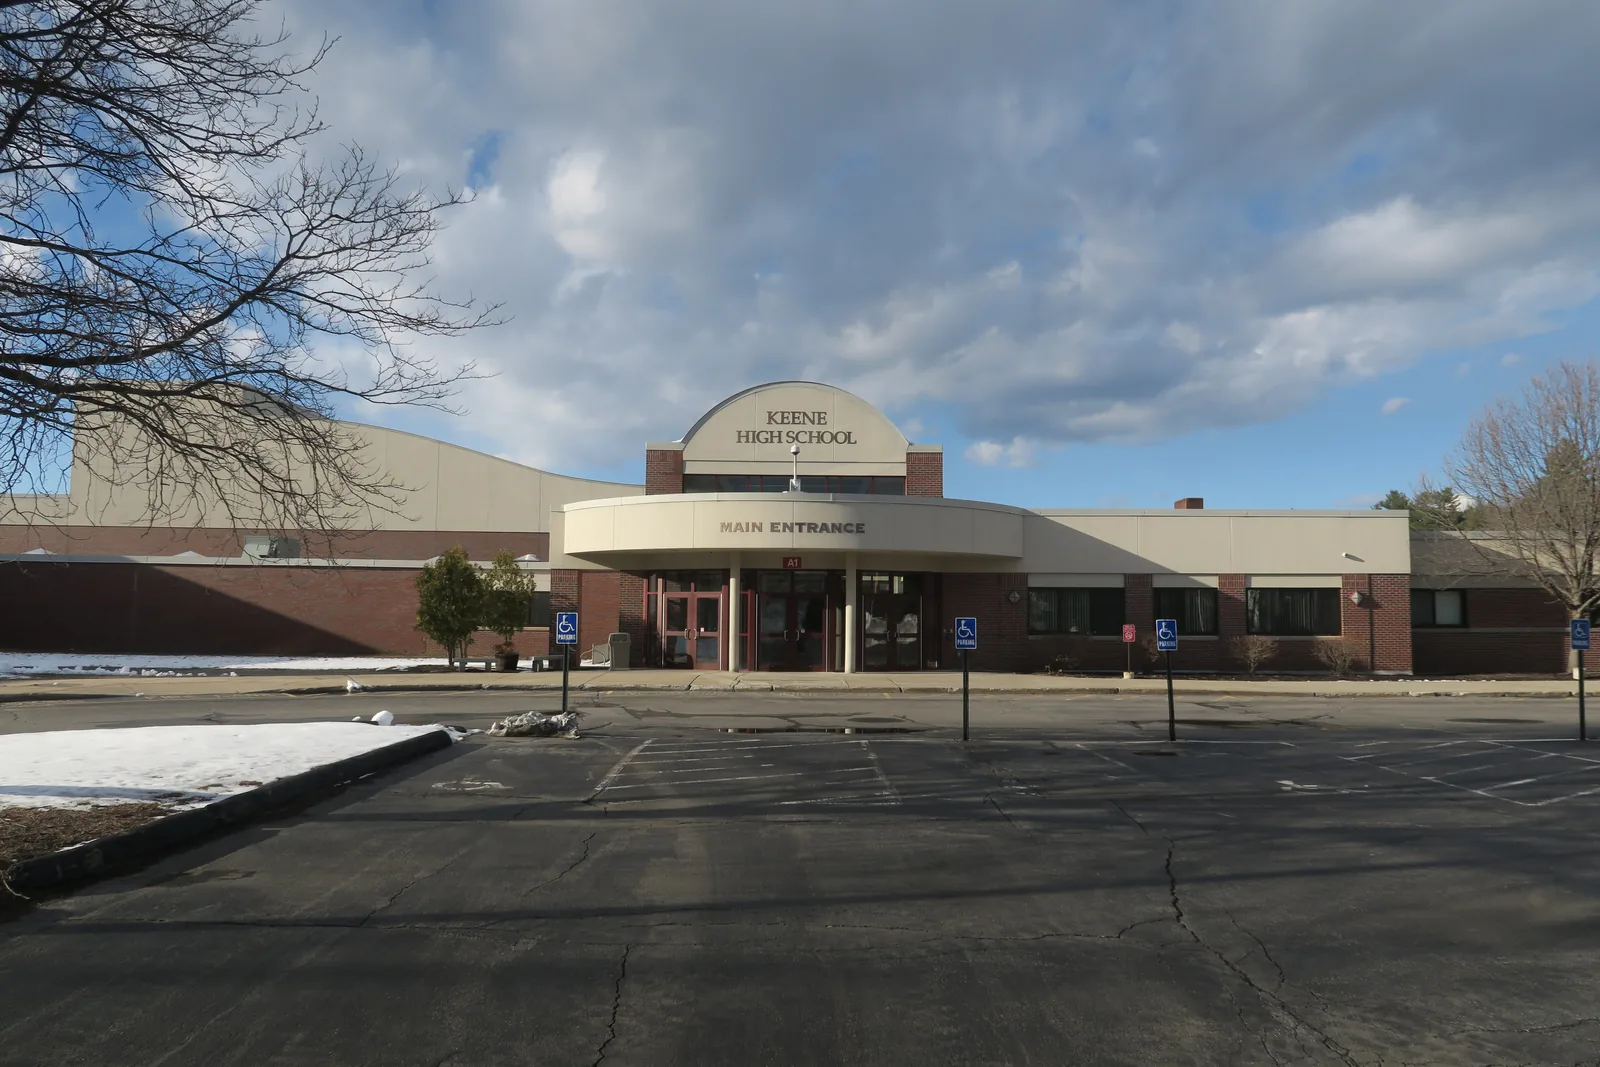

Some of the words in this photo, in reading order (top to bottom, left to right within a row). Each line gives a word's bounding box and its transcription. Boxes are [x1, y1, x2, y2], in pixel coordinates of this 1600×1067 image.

[766, 411, 828, 425] KEENE
[736, 430, 783, 444] HIGH
[786, 430, 857, 444] SCHOOL
[720, 522, 763, 533] MAIN
[770, 522, 866, 533] ENTRANCE
[788, 559, 798, 567] A1
